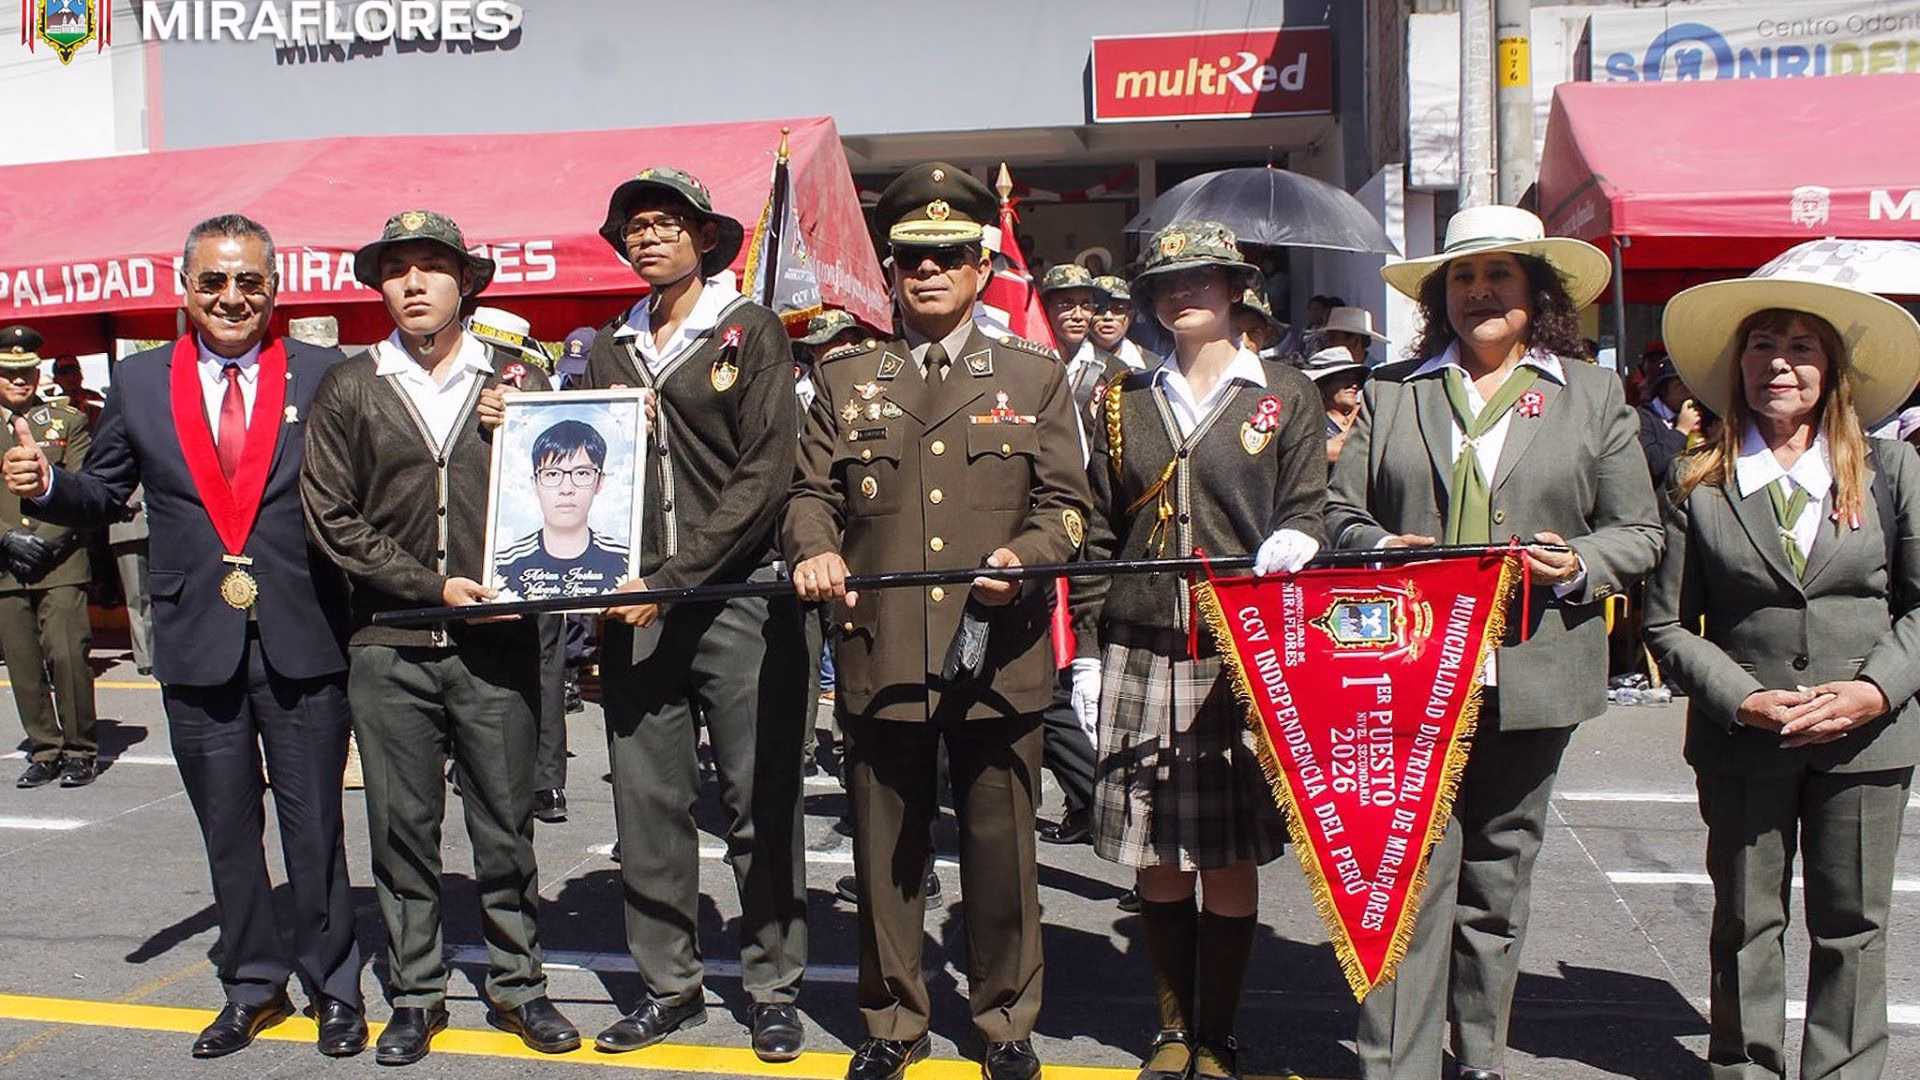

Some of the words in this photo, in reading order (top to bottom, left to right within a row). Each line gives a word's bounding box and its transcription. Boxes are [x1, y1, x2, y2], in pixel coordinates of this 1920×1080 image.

[1757, 18, 1839, 38] Centro
[1115, 51, 1308, 98] multiRed
[1282, 582, 1298, 667] MIRAFLORES
[1425, 593, 1477, 719] MUNICIPALIDAD
[1238, 606, 1270, 642] CCV
[1314, 801, 1344, 843] DEL
[1330, 845, 1372, 896] PERÚ
[1330, 727, 1357, 794] 2026
[1357, 711, 1368, 739] NIVEL
[1369, 709, 1396, 807] PUESTO
[1358, 743, 1370, 807] SECUNDARIA
[1399, 723, 1441, 803] DISTRITAL
[1391, 807, 1416, 833] DE
[1361, 835, 1408, 932] MIRAFLORES
